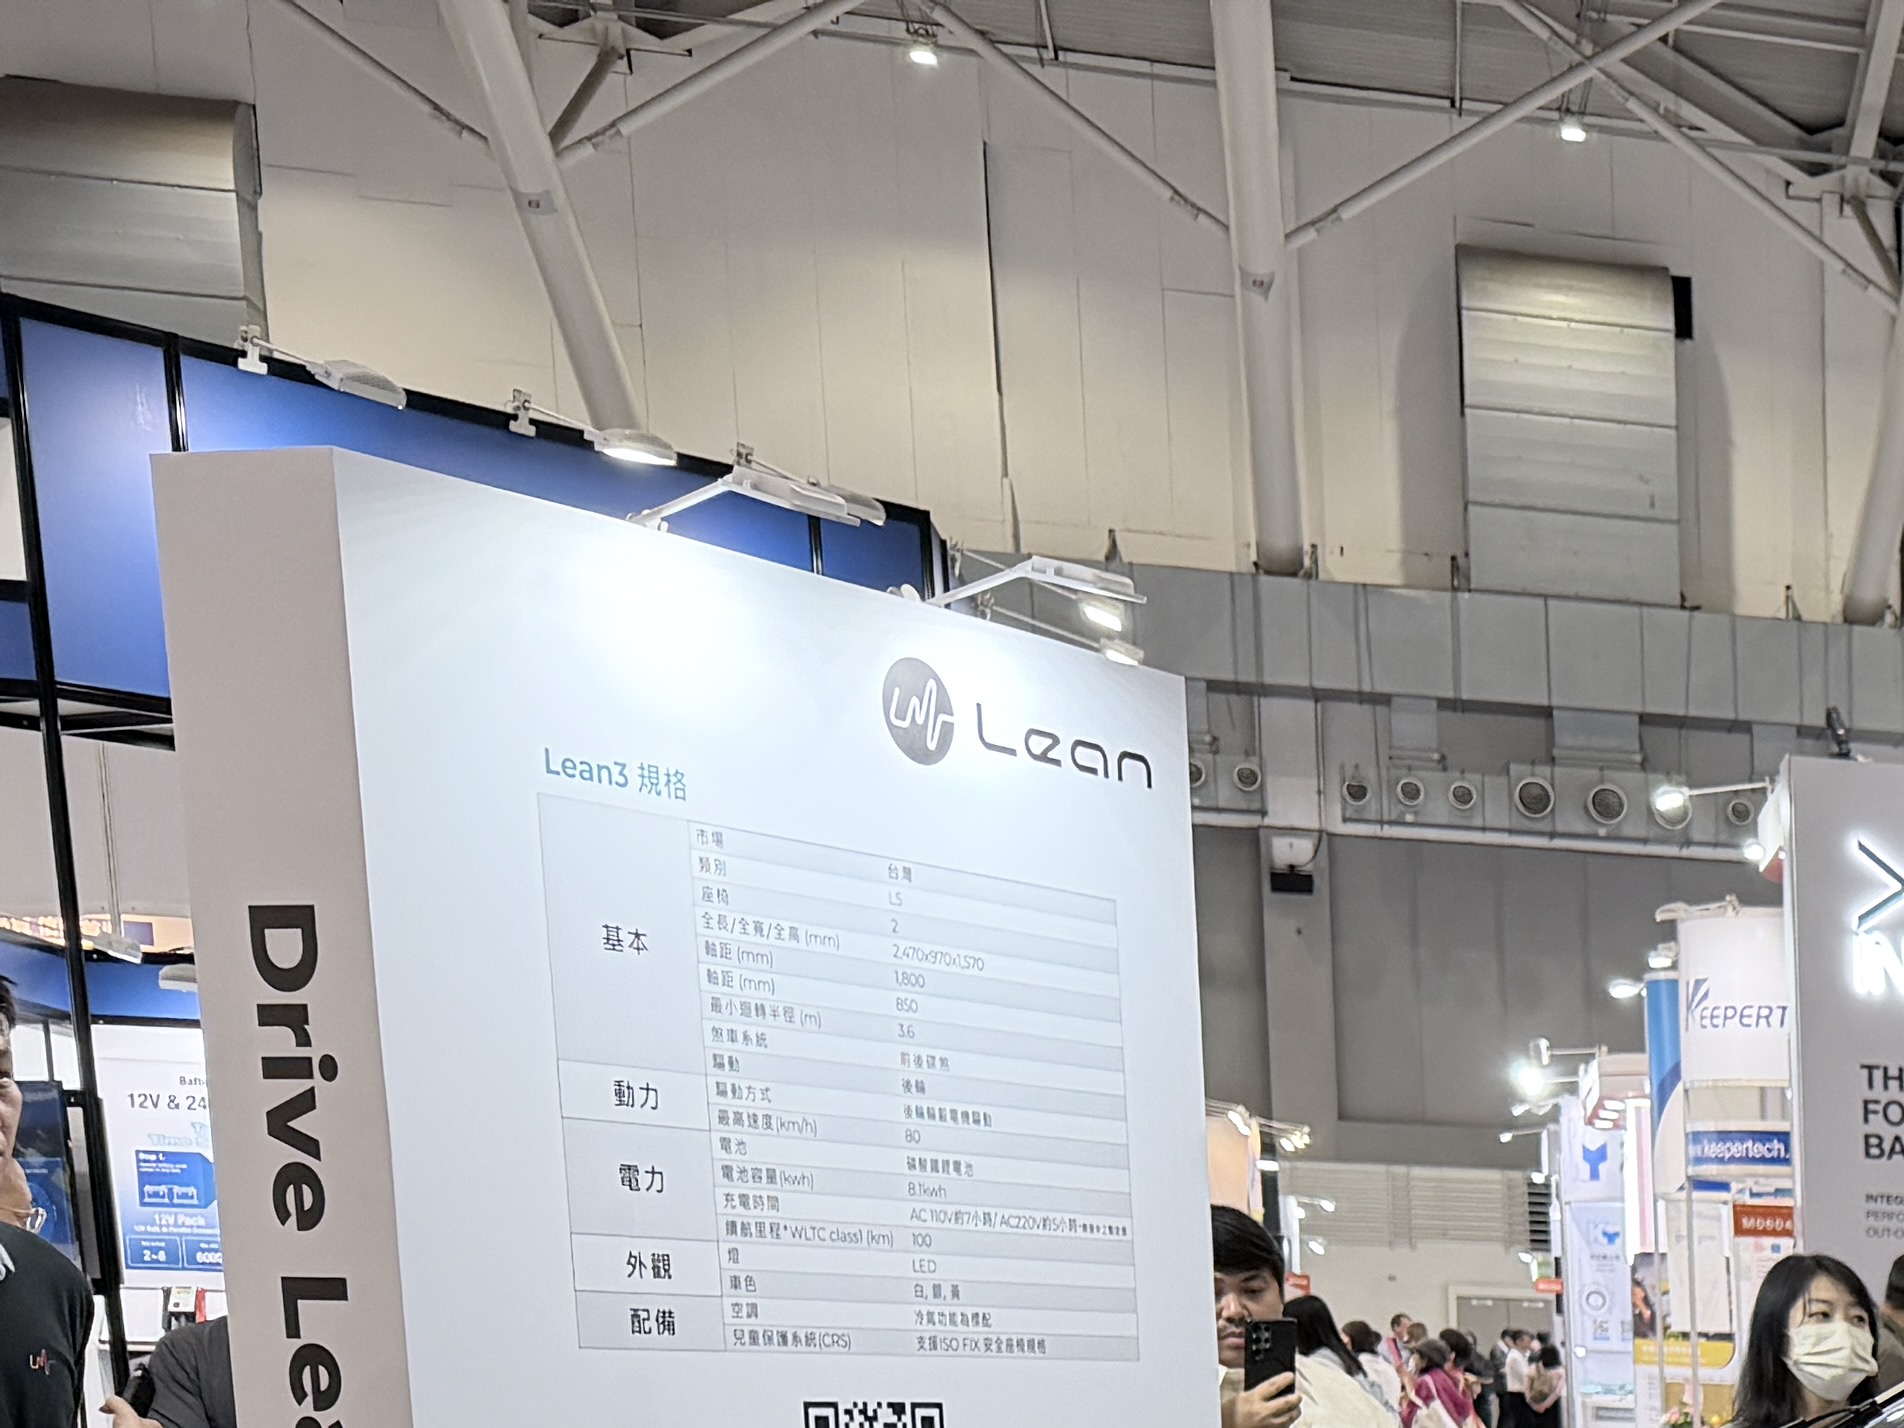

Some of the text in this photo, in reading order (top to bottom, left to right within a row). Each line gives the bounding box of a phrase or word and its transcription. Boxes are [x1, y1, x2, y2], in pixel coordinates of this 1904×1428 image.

[975, 702, 1154, 790] Lean
[543, 746, 688, 802] Lean3 規格
[890, 918, 899, 934] 2
[602, 922, 649, 957] 基本
[737, 946, 774, 969] (mm)
[739, 974, 776, 997] (mm)
[800, 1009, 822, 1030] (m)
[897, 1023, 915, 1040] 3.6
[247, 904, 339, 1233] Drive
[128, 1093, 161, 1109] 12V
[167, 1094, 180, 1110] &
[613, 1079, 660, 1111] 動力
[719, 1136, 748, 1156] 電池
[904, 1128, 921, 1145] 80
[618, 1163, 665, 1194] 電力
[723, 1192, 780, 1213] 充電時間
[912, 1232, 933, 1248] 100
[625, 1249, 673, 1280] 外觀
[912, 1258, 937, 1275] LED
[729, 1274, 757, 1293] 車色
[731, 1302, 759, 1320] 空調
[629, 1307, 676, 1338] 配備
